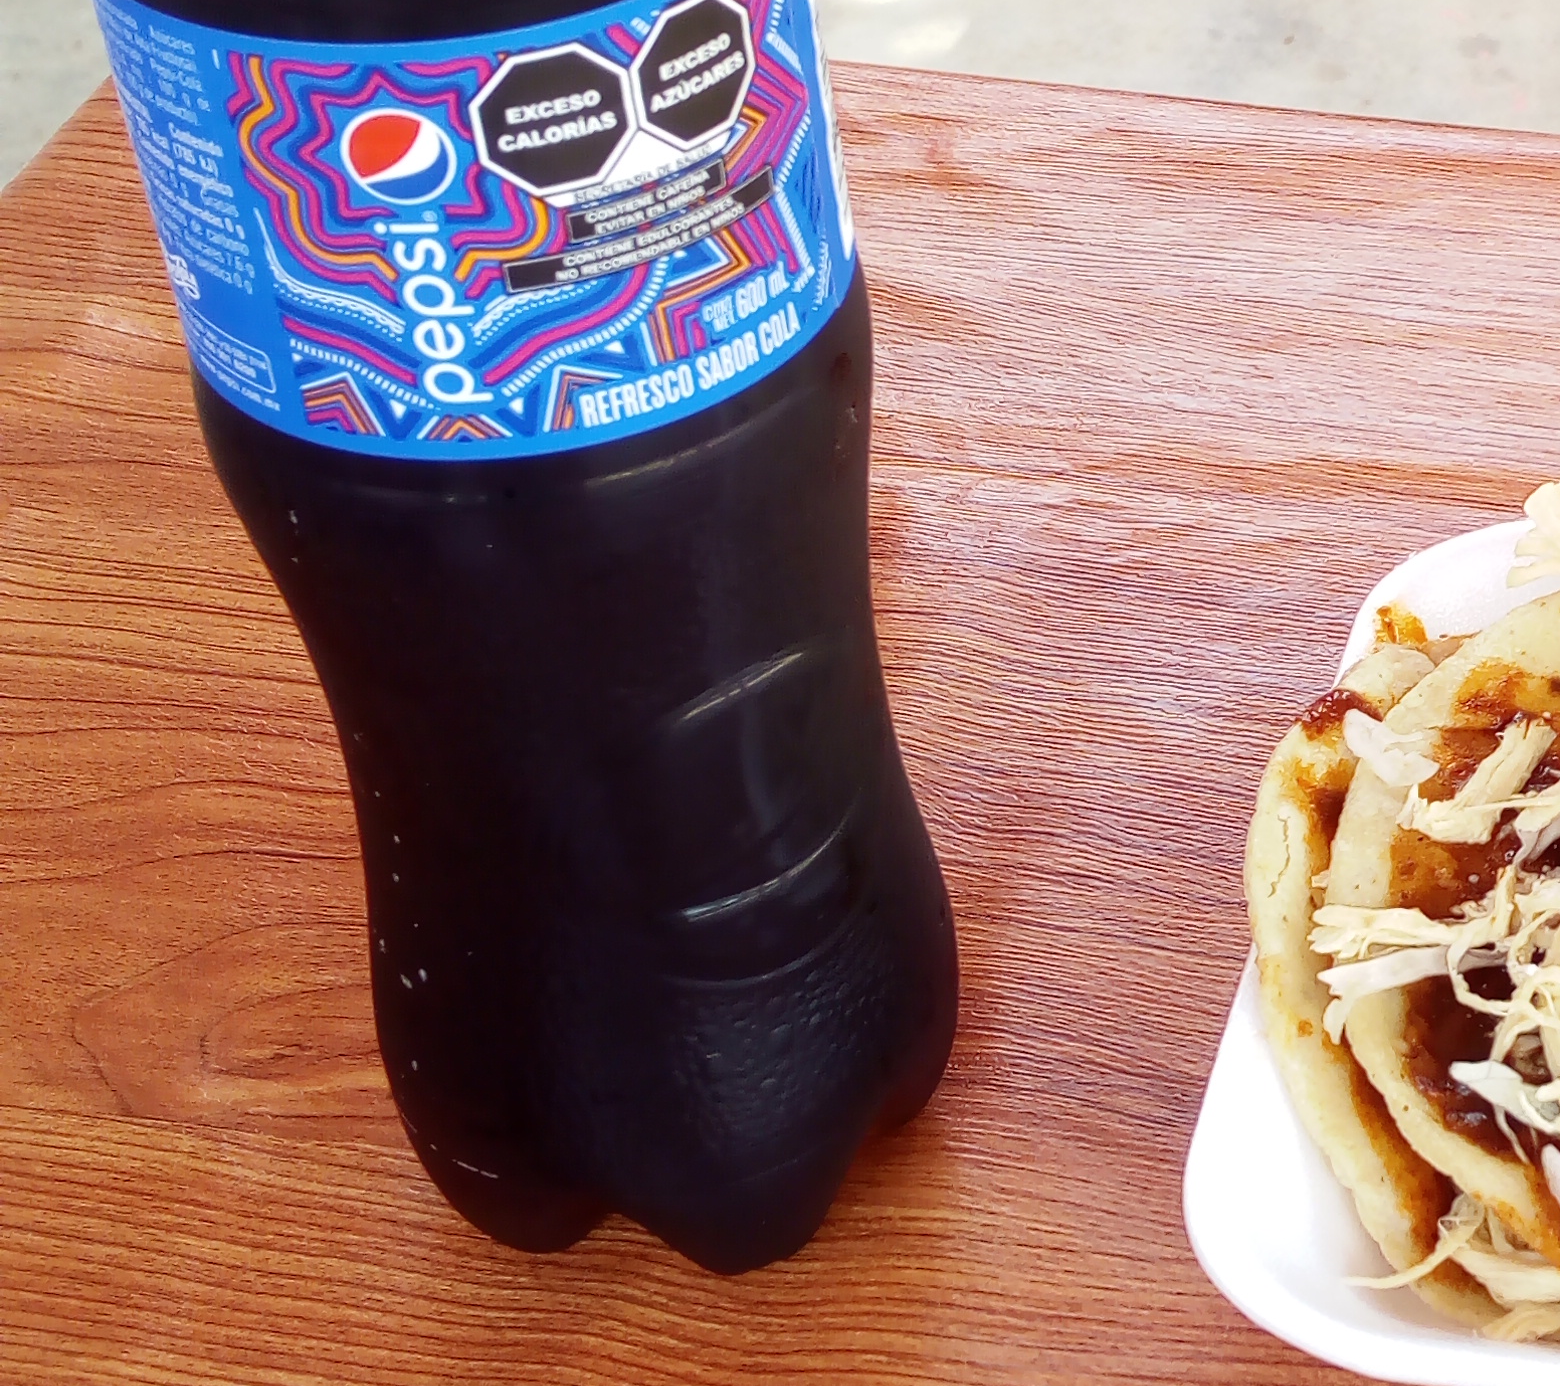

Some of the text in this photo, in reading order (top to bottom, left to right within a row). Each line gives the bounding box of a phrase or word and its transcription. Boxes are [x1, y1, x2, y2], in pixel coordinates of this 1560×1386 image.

[659, 32, 731, 82] EXCESO
[650, 50, 746, 113] AZÚCARES
[504, 89, 602, 125] EXCESO
[497, 111, 618, 153] CALORÍAS
[655, 163, 671, 178] DE
[563, 194, 735, 266] CONTIENE EDULCORANTES
[585, 191, 655, 223] CONTIENE
[594, 209, 646, 235] EVITAR
[646, 202, 666, 218] EN
[555, 266, 579, 282] NO
[580, 229, 692, 276] RECOMENDABLE
[691, 222, 711, 239] EN
[373, 221, 494, 404] pepsi
[735, 275, 768, 320] 600
[578, 301, 801, 428] REFRESCO SABOR COLA
